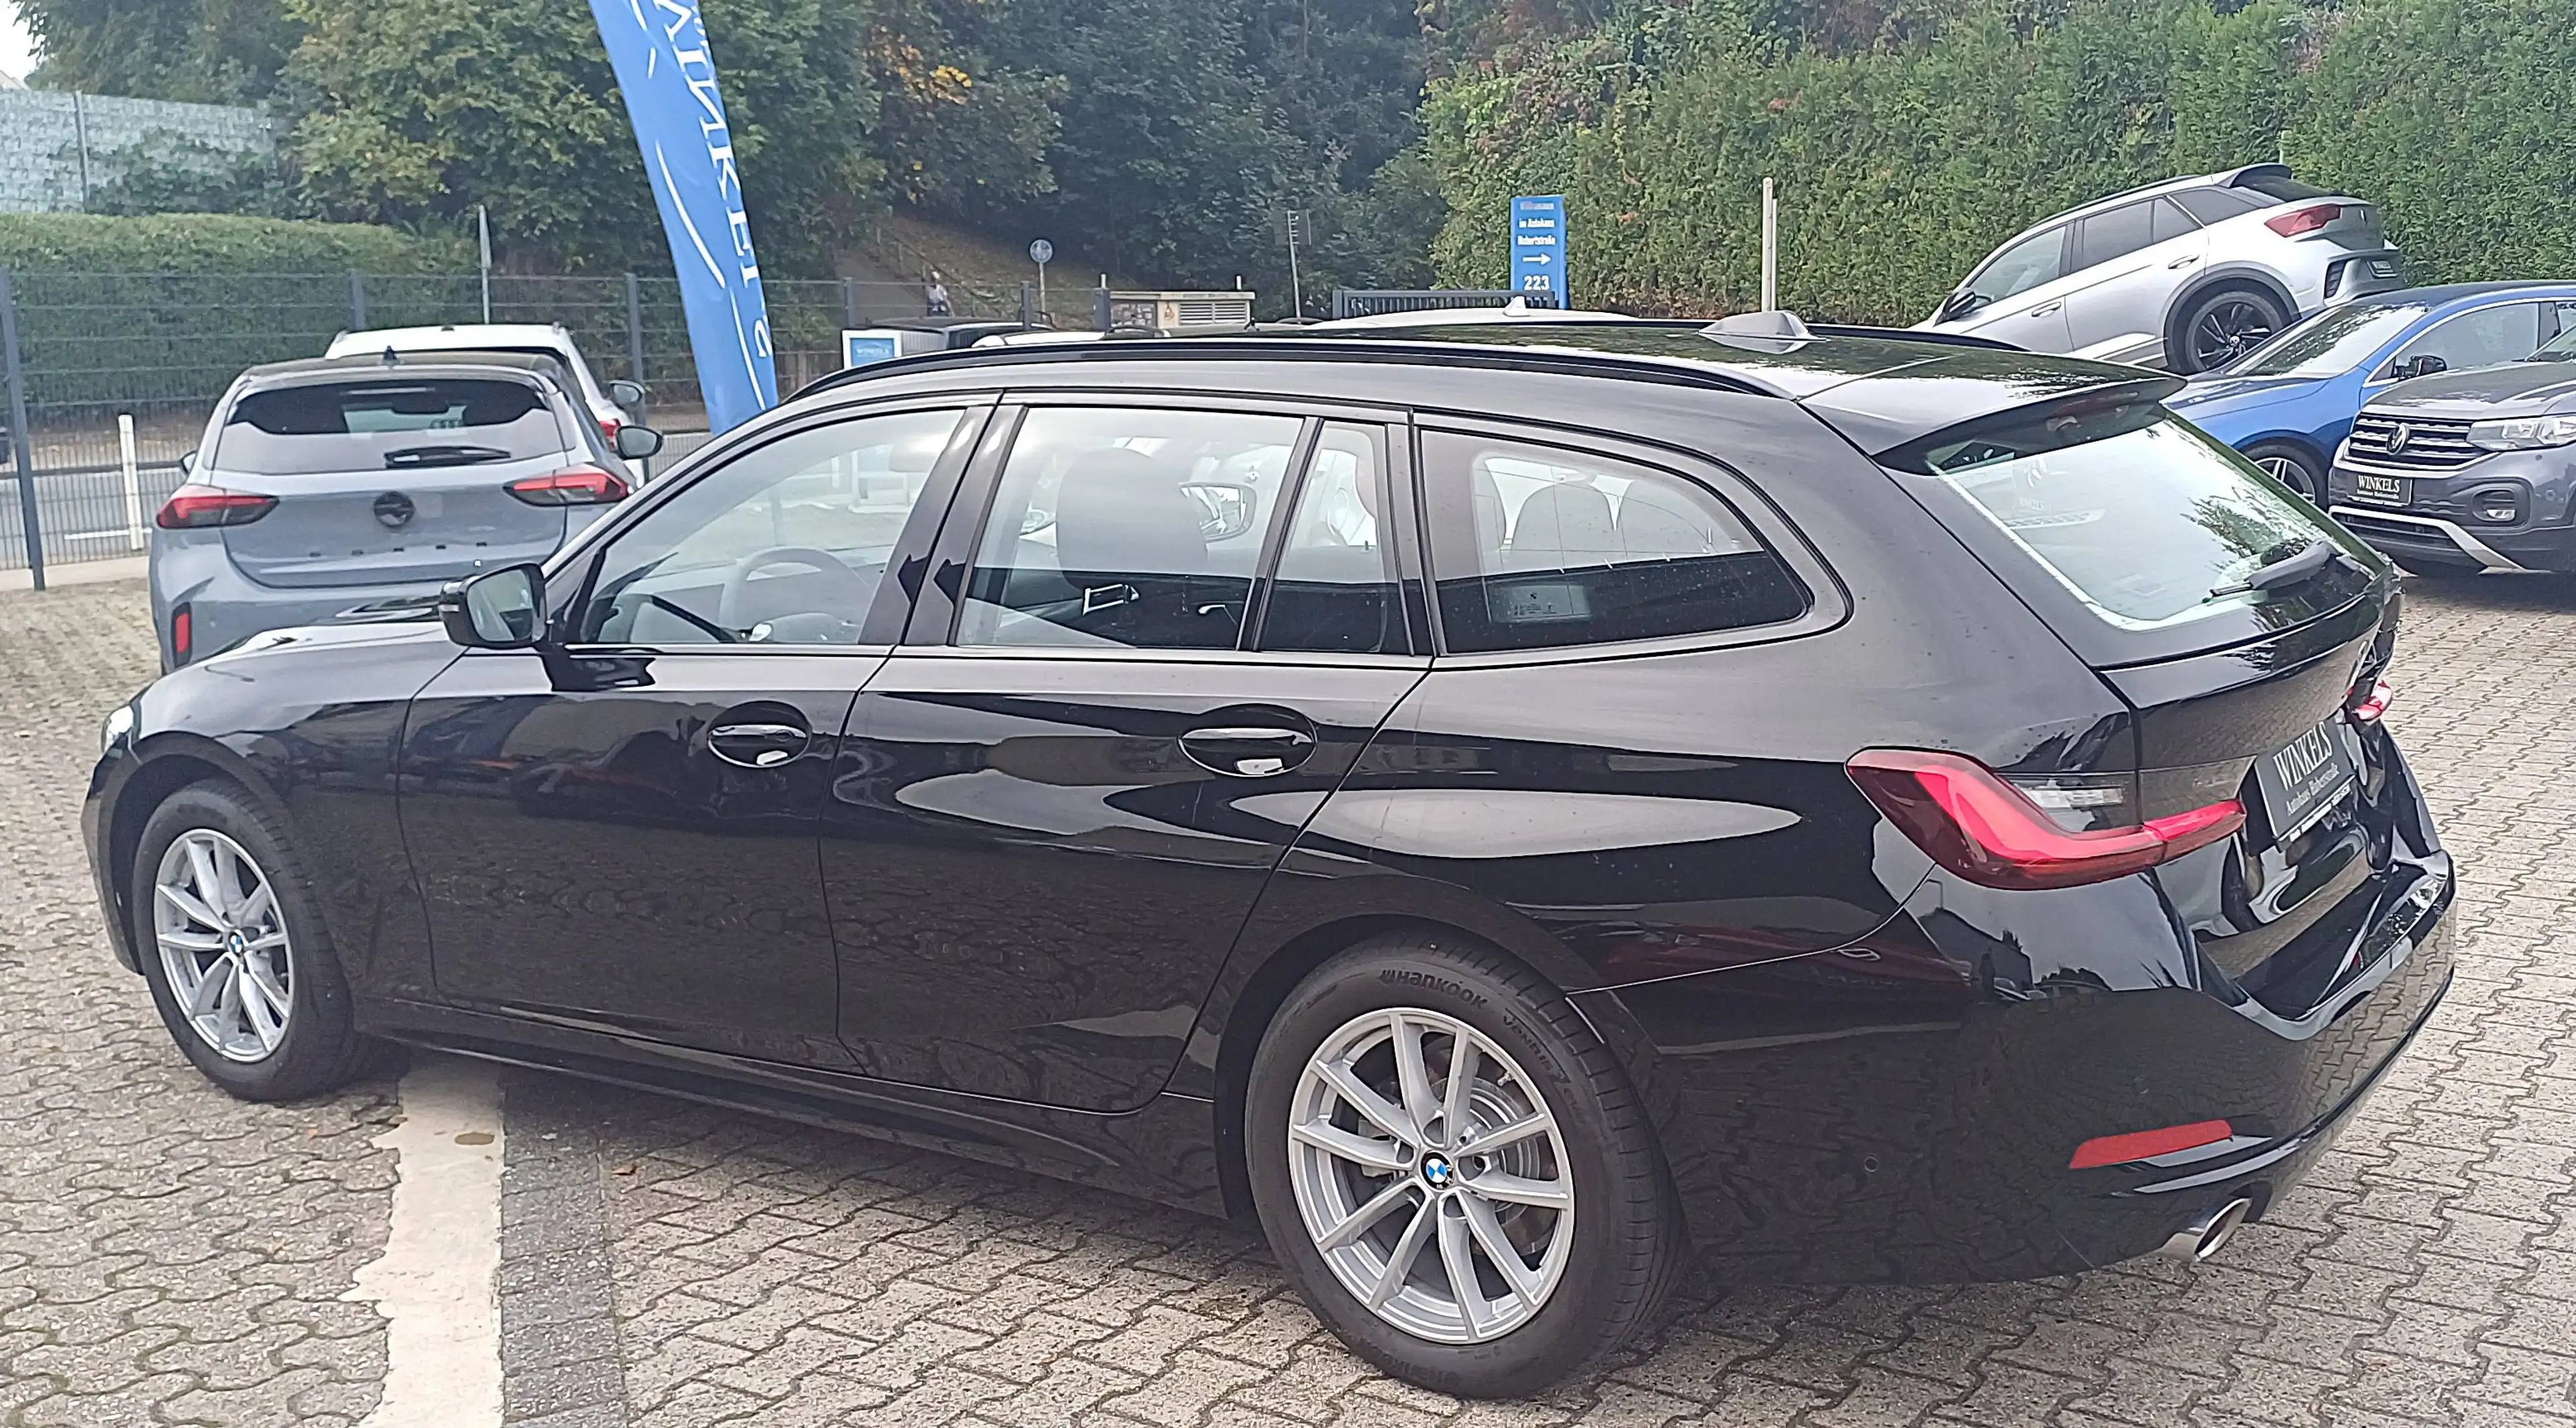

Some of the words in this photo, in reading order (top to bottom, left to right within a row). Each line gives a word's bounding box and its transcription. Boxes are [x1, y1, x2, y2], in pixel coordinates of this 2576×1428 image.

[1523, 275, 1550, 291] 223
[2357, 474, 2400, 493] WINKELS
[2272, 721, 2332, 791] WINKELS
